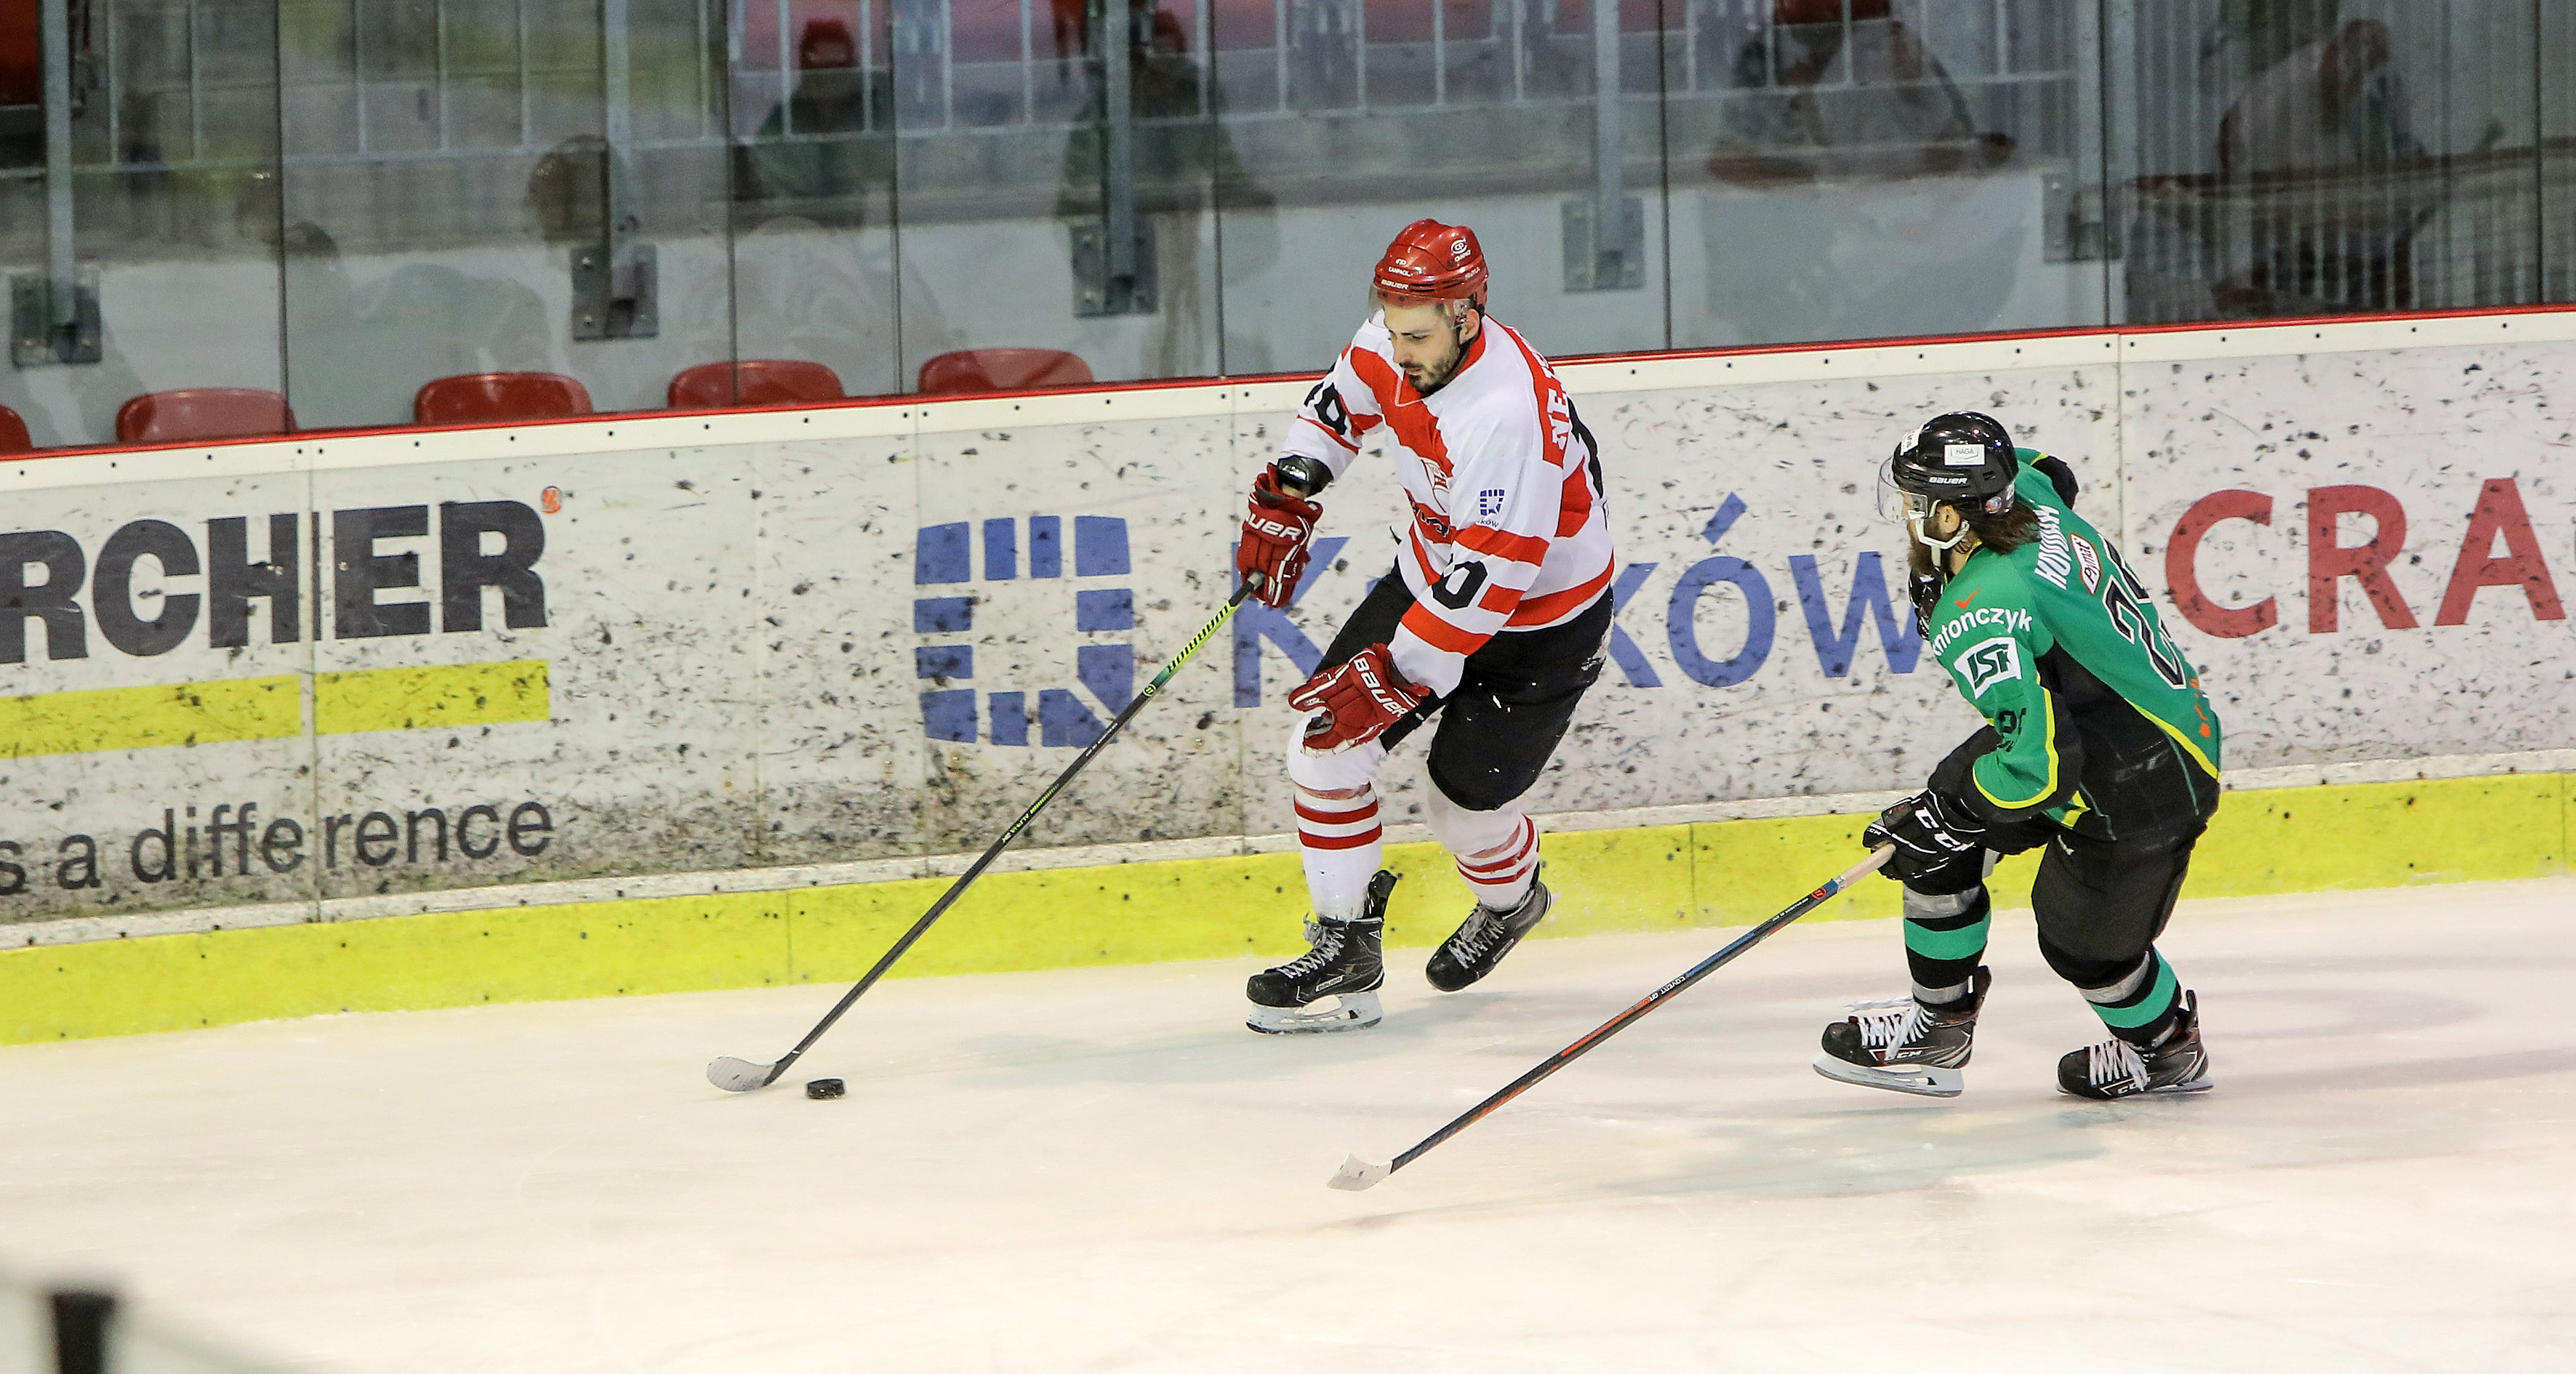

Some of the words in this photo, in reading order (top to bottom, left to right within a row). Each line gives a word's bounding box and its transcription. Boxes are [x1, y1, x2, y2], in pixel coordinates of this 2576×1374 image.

[1929, 476, 1967, 485] BAUER
[1245, 513, 1303, 542] UER
[2165, 477, 2576, 638] CRA
[1168, 605, 1229, 673] WARRIOR
[1353, 657, 1409, 718] BAUER
[57, 833, 100, 891] a
[131, 800, 554, 883] difference
